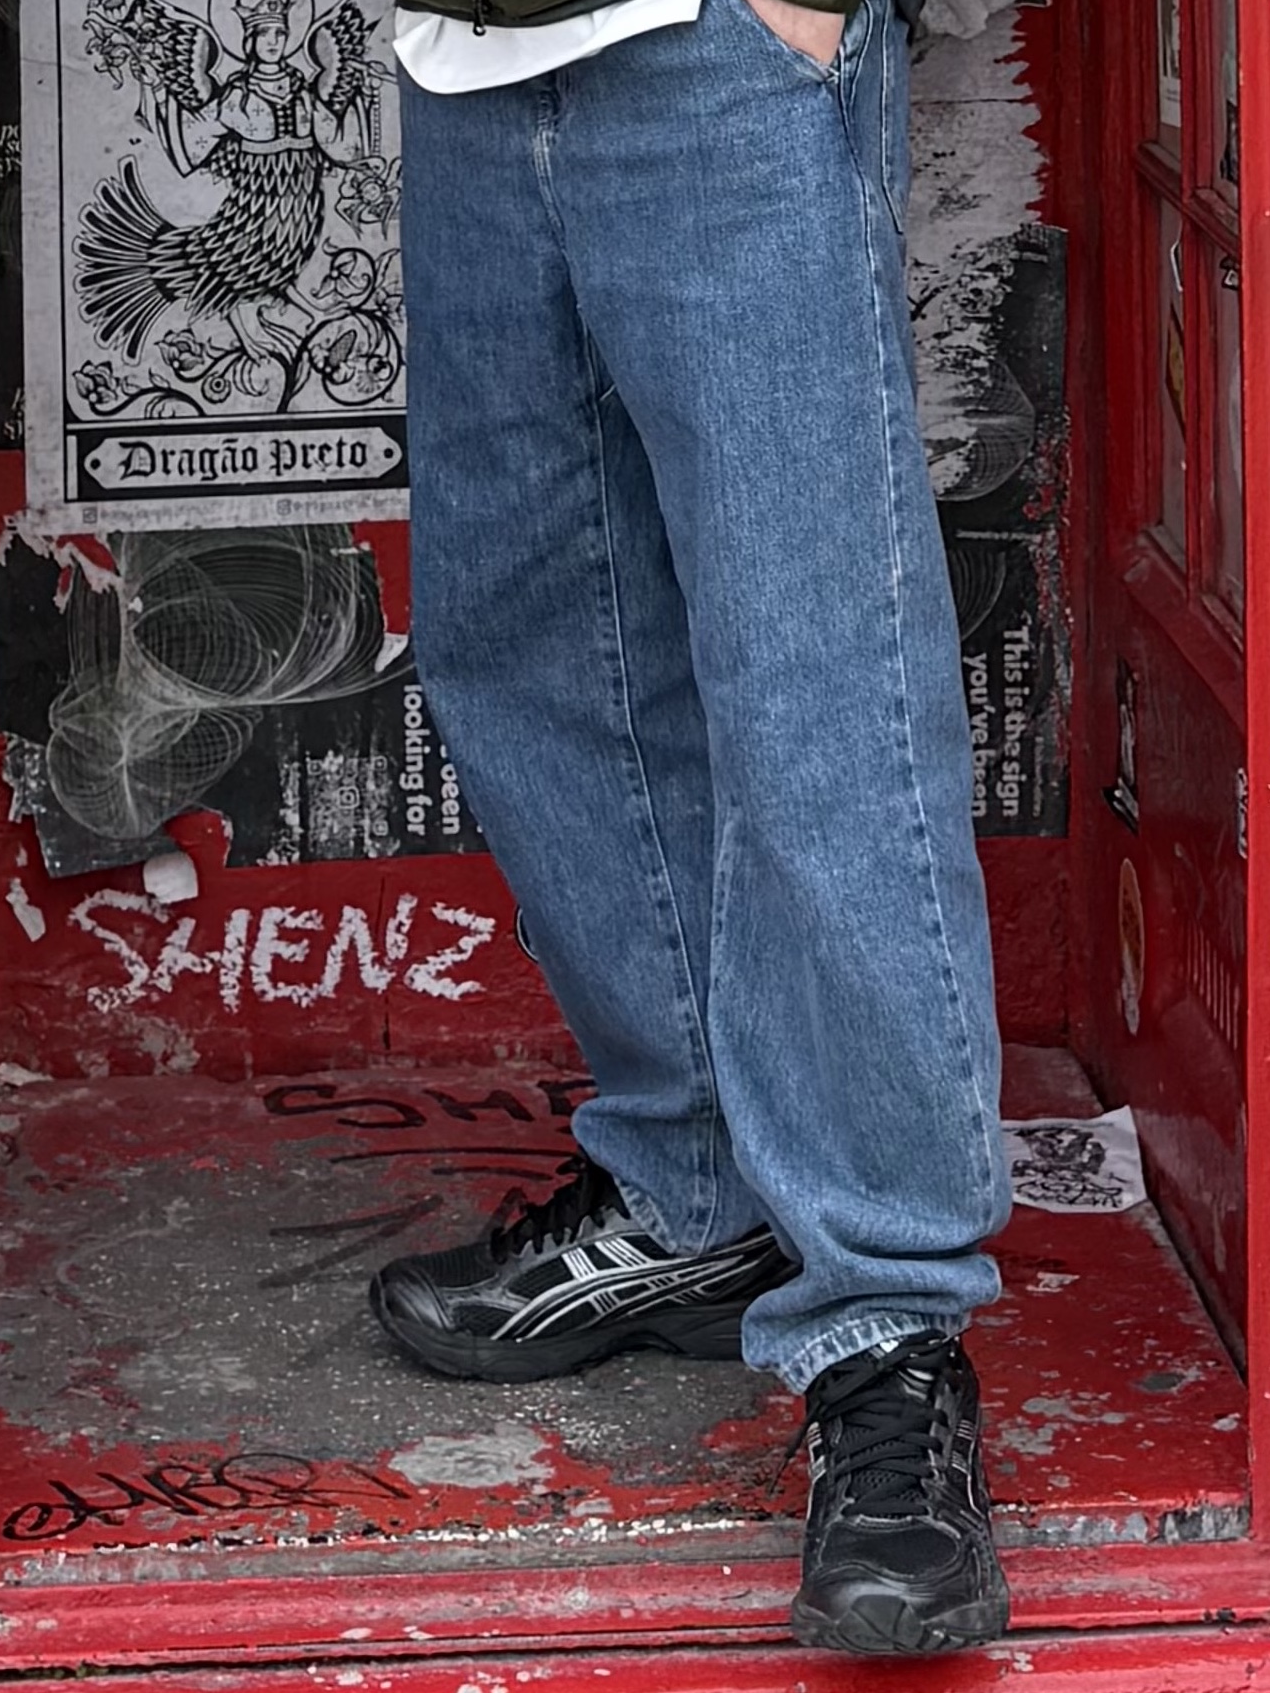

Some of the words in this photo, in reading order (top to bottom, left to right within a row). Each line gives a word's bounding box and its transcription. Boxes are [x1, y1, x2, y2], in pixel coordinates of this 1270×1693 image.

[118, 439, 259, 482] Dragão
[268, 438, 368, 482] Preto
[1000, 626, 1031, 683] This
[1000, 688, 1029, 704] is
[999, 711, 1028, 756] the
[995, 760, 1027, 819] sign
[400, 794, 429, 837] for
[67, 886, 498, 1014] SHENZ
